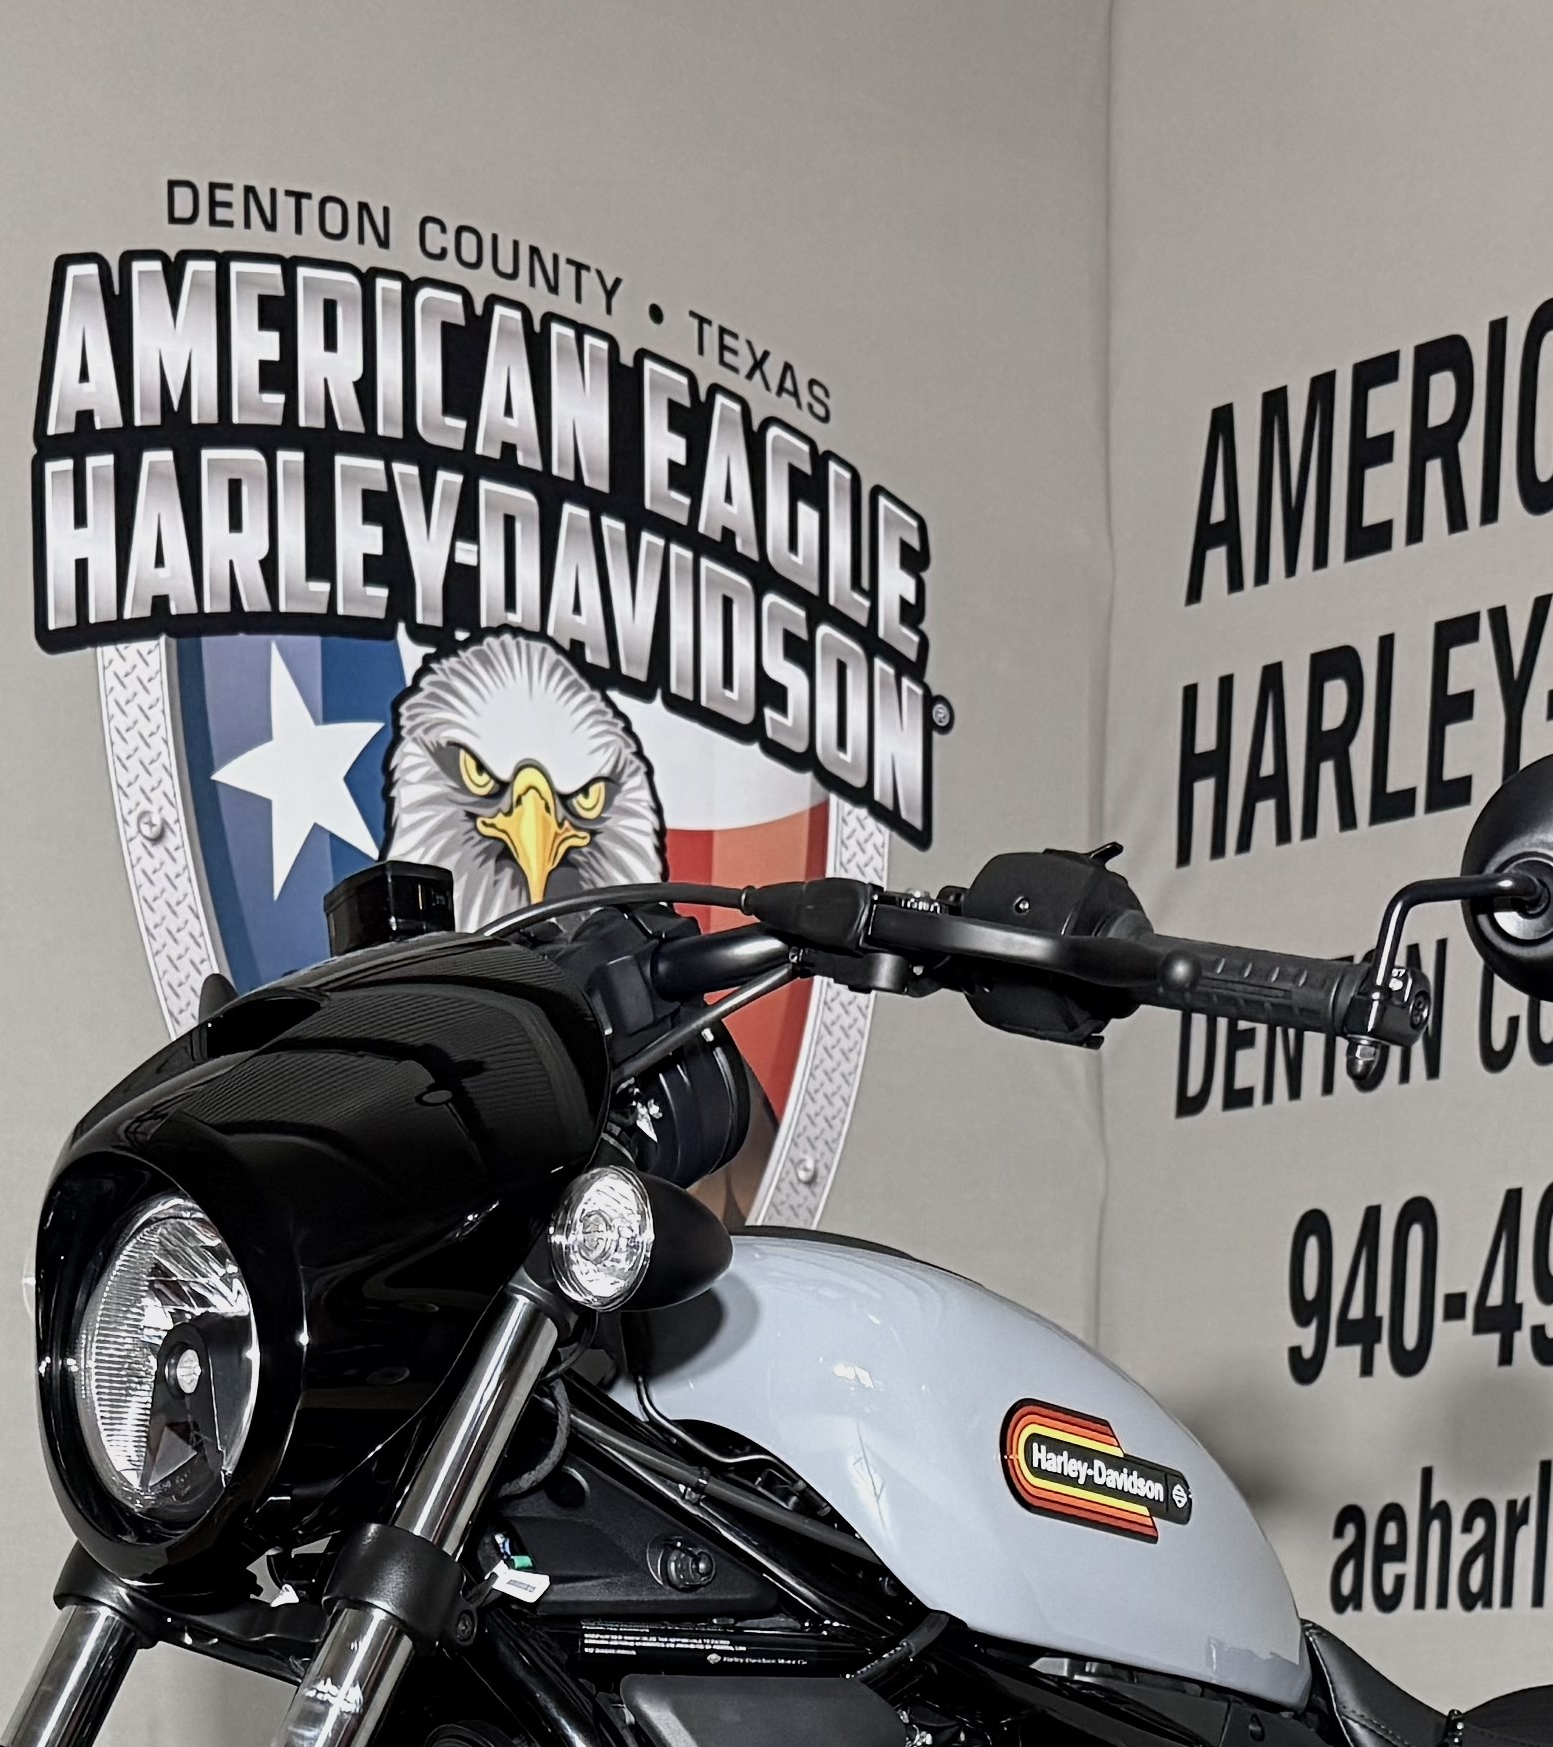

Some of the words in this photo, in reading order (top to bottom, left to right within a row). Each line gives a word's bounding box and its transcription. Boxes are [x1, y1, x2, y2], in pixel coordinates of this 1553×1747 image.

[167, 178, 391, 250] DENTON
[418, 214, 623, 316] COUNTY
[689, 309, 832, 426] TEXAS
[43, 256, 613, 494] AMERICAN
[640, 370, 925, 656] EAGLE
[1031, 1441, 1165, 1502] Harley-Davidson
